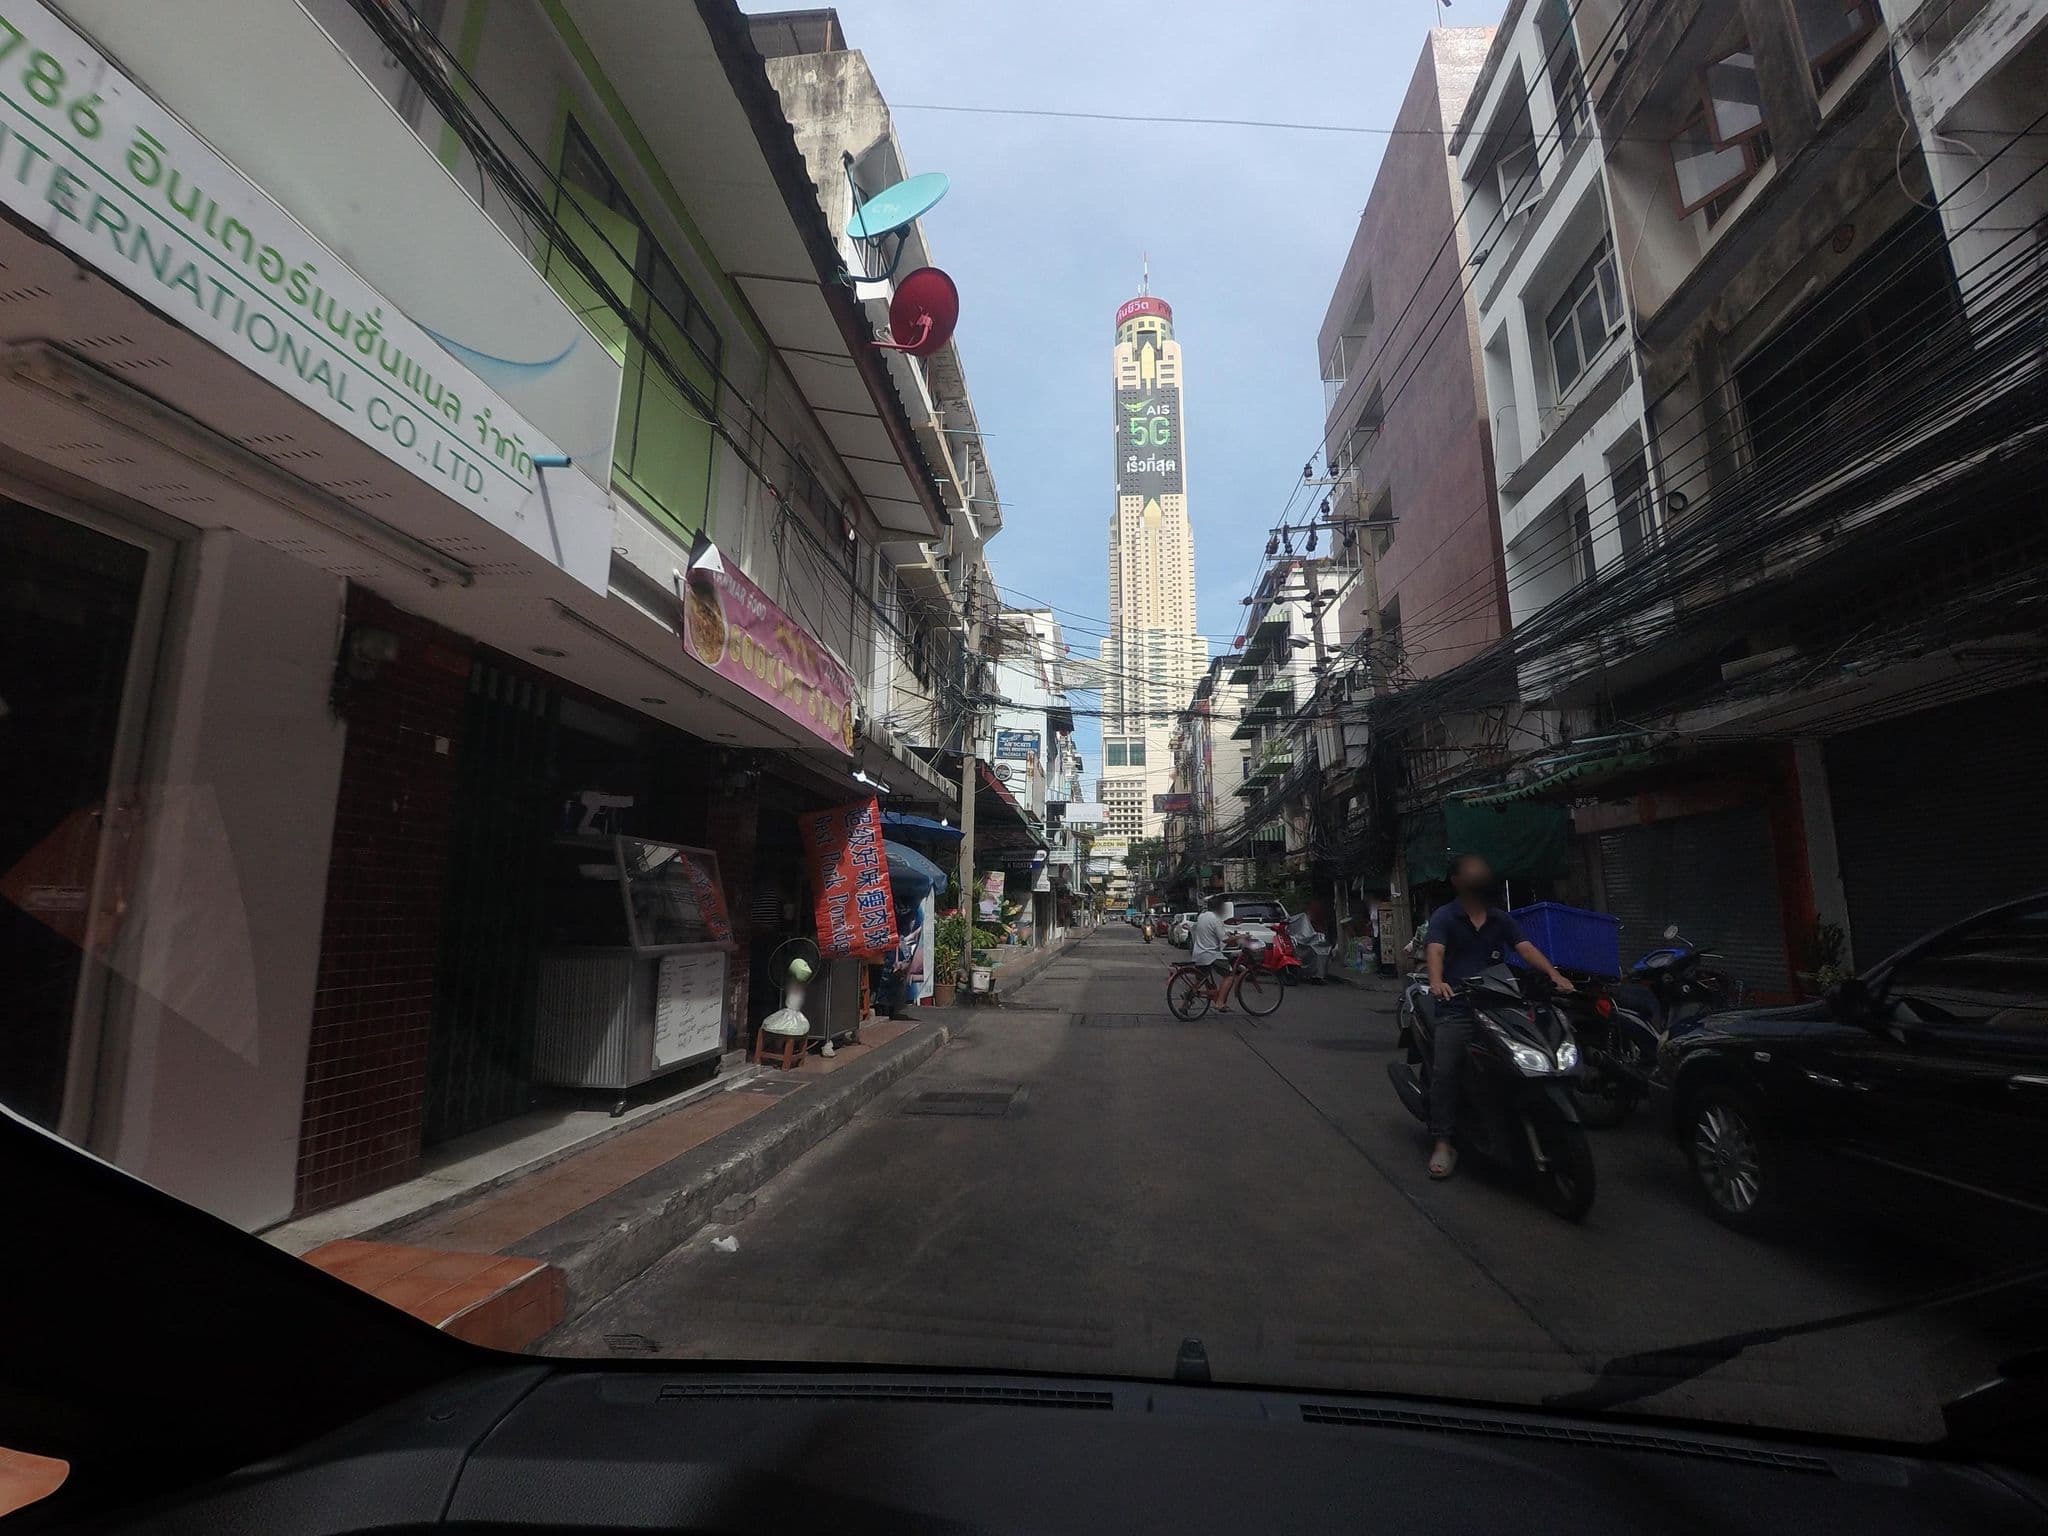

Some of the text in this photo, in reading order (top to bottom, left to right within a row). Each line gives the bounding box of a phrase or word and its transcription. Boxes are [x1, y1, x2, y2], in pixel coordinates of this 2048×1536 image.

[0, 119, 355, 412] TERNATIONAL
[126, 124, 462, 424] อินเตอร์เนชั่นแนล
[1146, 404, 1170, 415] AIS
[1130, 417, 1170, 447] 5G
[1127, 452, 1176, 477] เร็วที่สุด
[820, 850, 848, 891] Pork
[827, 891, 858, 958] Porridge
